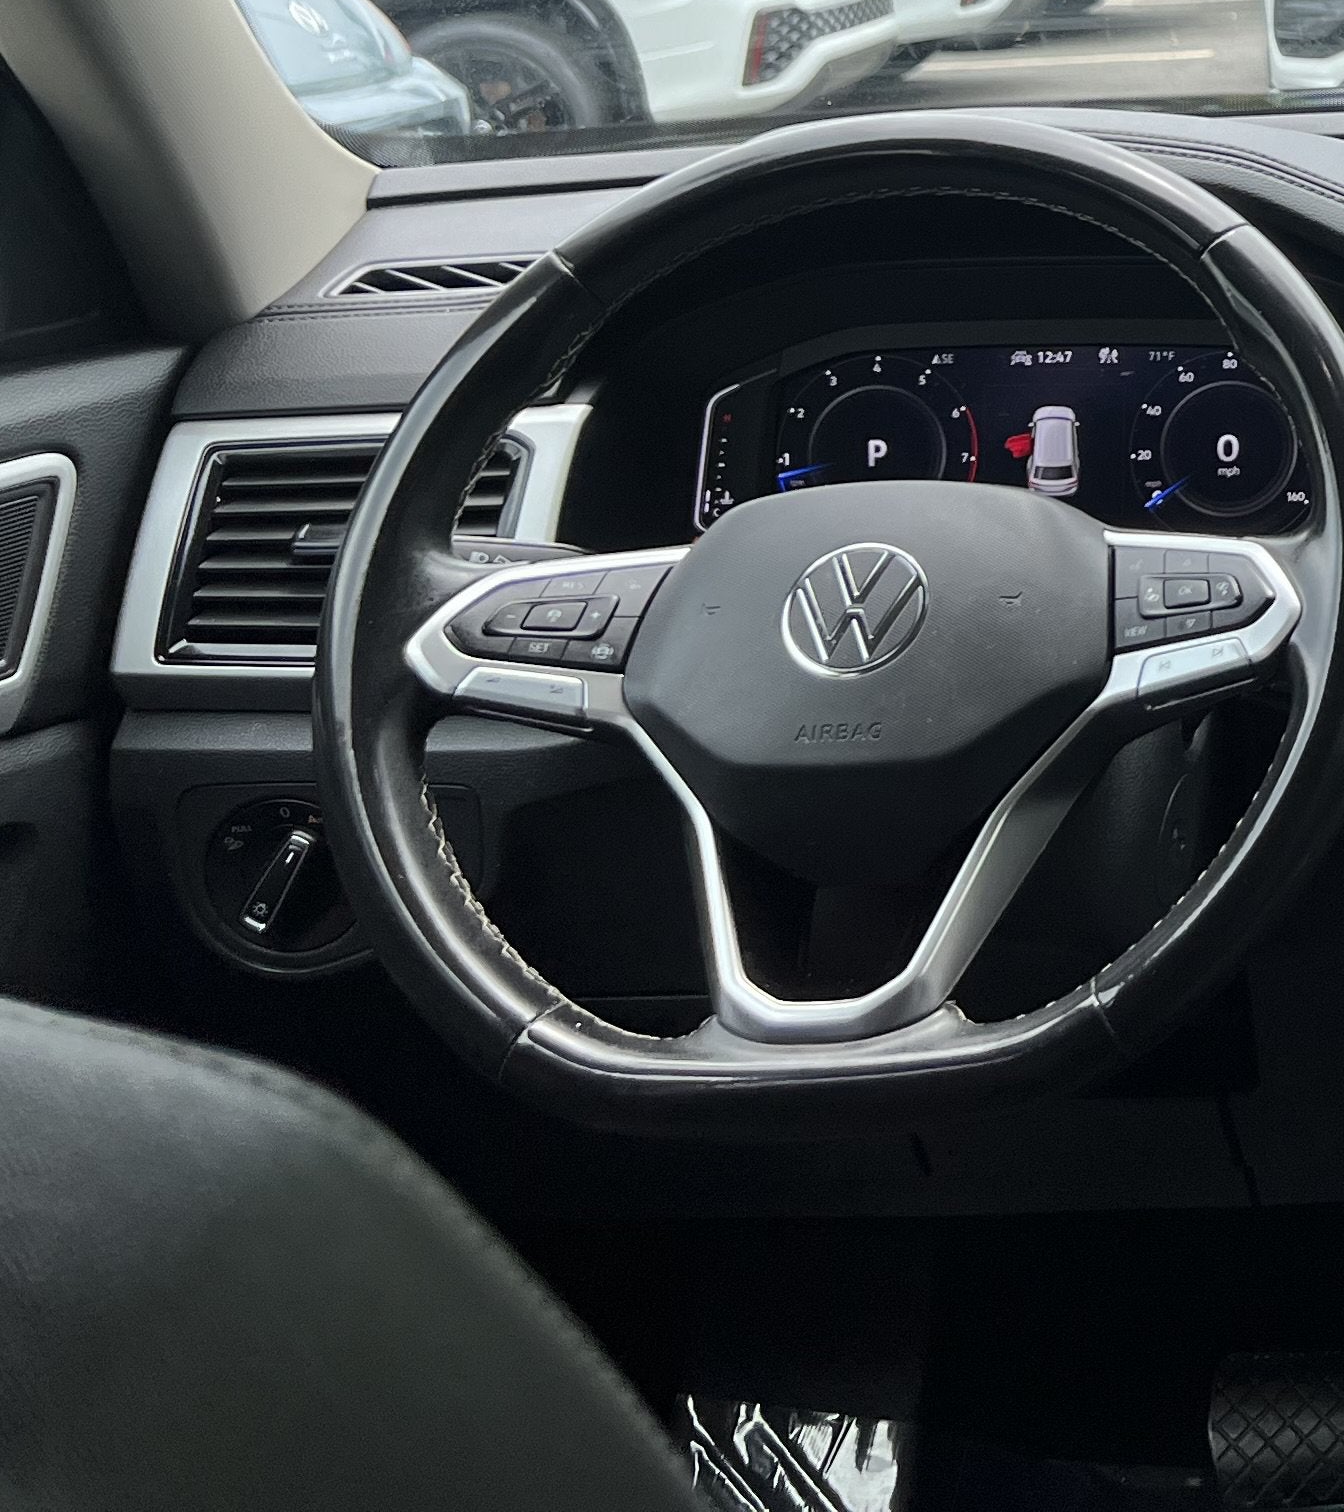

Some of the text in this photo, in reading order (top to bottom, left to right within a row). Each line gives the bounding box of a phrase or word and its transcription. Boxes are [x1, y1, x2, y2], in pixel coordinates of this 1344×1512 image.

[1037, 351, 1073, 364] 12:47
[872, 363, 882, 373] 4
[1222, 358, 1238, 370] 80
[829, 375, 838, 387] 3
[918, 374, 927, 386] 5
[1178, 371, 1195, 383] 60
[796, 407, 805, 419] 2
[951, 408, 959, 419] 6
[1147, 405, 1162, 416] 40
[867, 439, 888, 467] P
[1216, 433, 1240, 462] 0
[783, 452, 791, 466] 1
[960, 452, 969, 464] 7
[1137, 449, 1152, 461] 20
[1217, 465, 1241, 478] mph
[1286, 491, 1307, 504] 160
[781, 542, 928, 679] VW
[795, 722, 882, 744] AIRBAG
